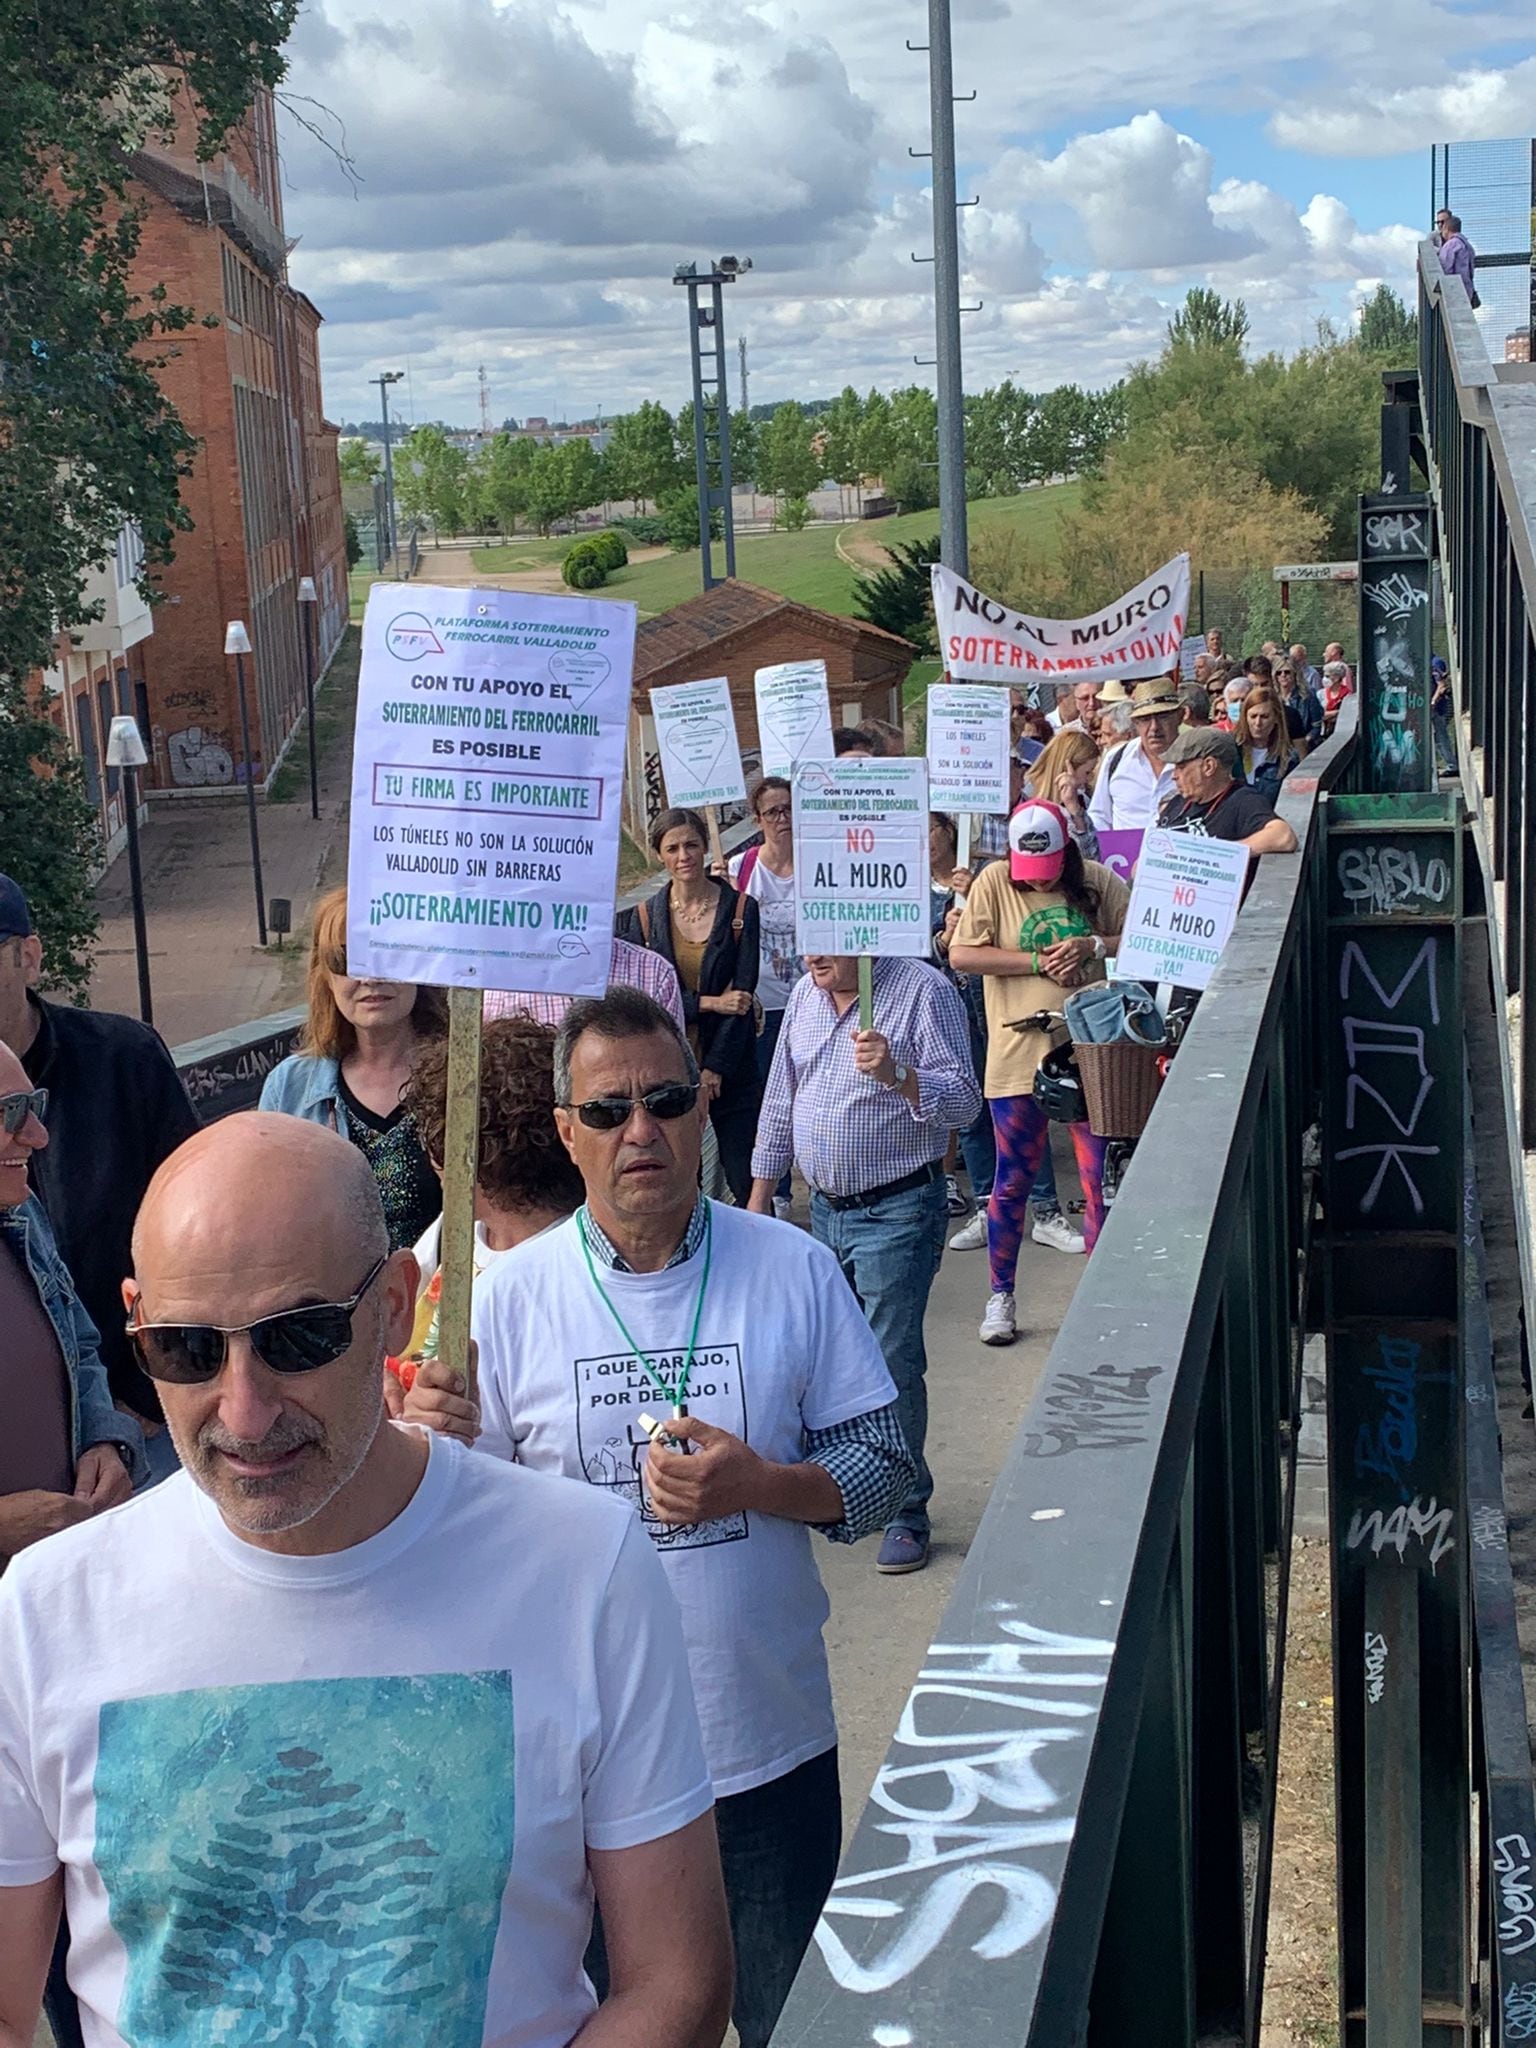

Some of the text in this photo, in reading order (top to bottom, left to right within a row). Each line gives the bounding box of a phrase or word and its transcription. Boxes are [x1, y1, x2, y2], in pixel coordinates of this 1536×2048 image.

[435, 616, 610, 638] PLATAFORMA SOTERRAMIENTO
[954, 584, 1171, 646] NO AL MURO
[444, 631, 597, 651] FERROCARRIL VALLADOLID
[411, 675, 572, 699] CON TU APOYO EL
[382, 701, 600, 737] SOTERRAMIENTO DEL FERROCARRIL
[945, 731, 957, 741] LOS
[432, 739, 541, 760] ES POSIBLE
[938, 759, 950, 769] SON
[385, 775, 589, 809] TU FIRMA ES IMPORTANTE
[855, 789, 884, 797] APOYO,
[851, 814, 886, 822] POSIBLE
[373, 824, 594, 856] LOS TÚNELES NO SON LA SOLUCIÓN
[846, 828, 875, 854] NO
[386, 853, 561, 882] VALLADOLID SIN BARRERAS
[814, 862, 907, 889] AL MURO
[1173, 885, 1197, 907] NO
[370, 892, 588, 932] ¡¡SOTERRAMIENTO YA!!
[803, 902, 920, 922] SOTERRAMIENTO
[1141, 907, 1216, 938] AL MURO
[844, 926, 879, 950] ¡¡YA!!
[1127, 934, 1220, 964] SOTERRAMIENTO
[597, 1359, 638, 1376] QUE
[645, 1352, 730, 1371] CARAJO,
[626, 1374, 653, 1388] LA
[591, 1393, 631, 1408] POR
[639, 1384, 717, 1404] DEBAJO
